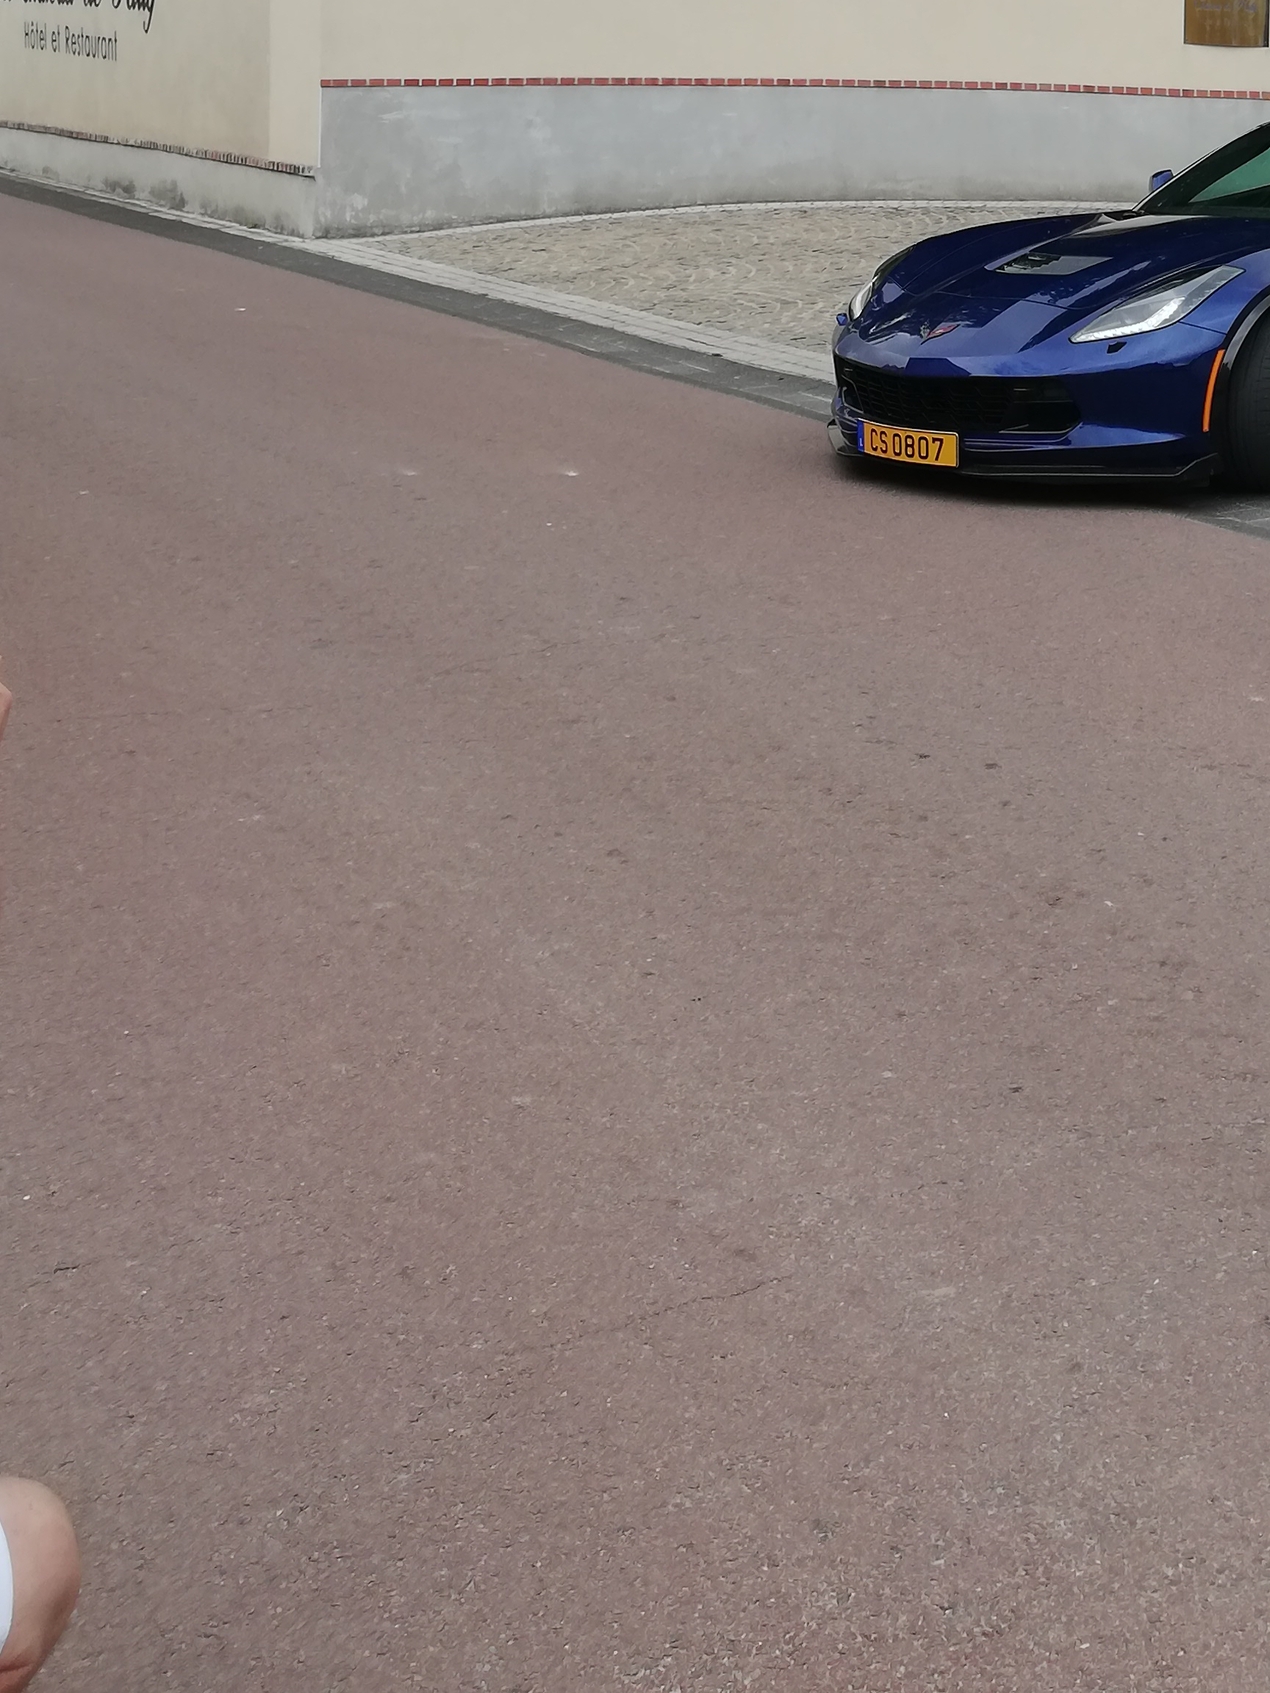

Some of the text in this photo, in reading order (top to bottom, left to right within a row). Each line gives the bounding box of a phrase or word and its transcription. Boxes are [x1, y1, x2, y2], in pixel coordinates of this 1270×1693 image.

[24, 21, 118, 62] Hôtel et Restaurant
